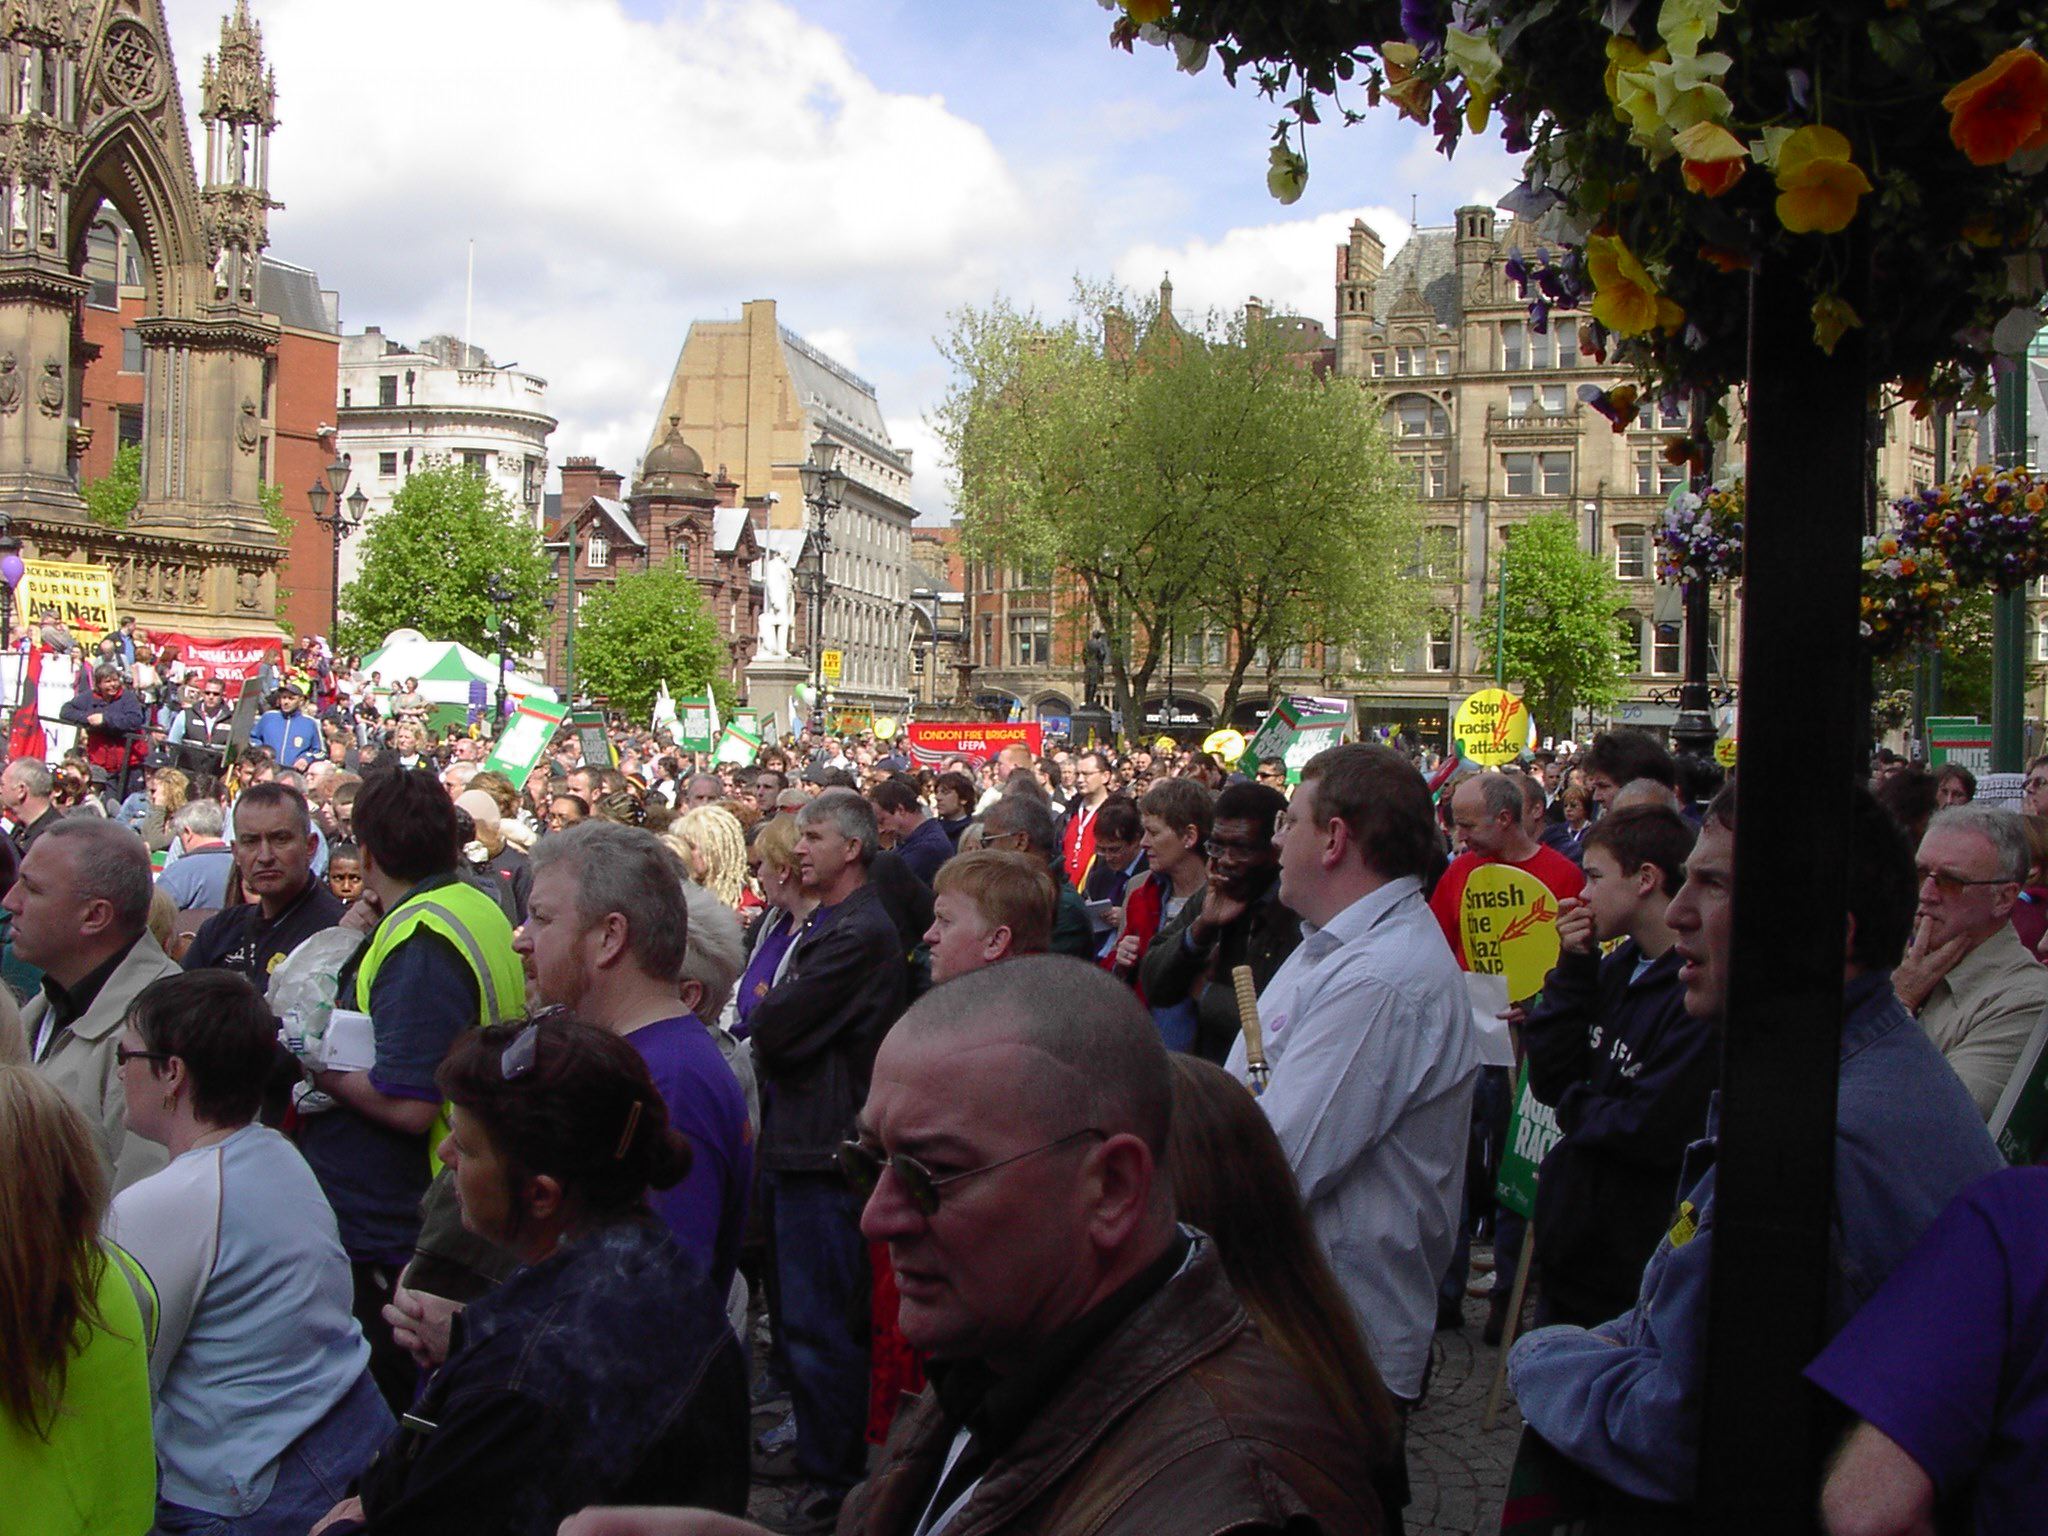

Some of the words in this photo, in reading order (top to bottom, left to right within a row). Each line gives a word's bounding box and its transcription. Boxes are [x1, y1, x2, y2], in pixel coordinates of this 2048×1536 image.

[44, 569, 60, 578] AND
[29, 582, 99, 597] BURNLEY
[66, 601, 107, 623] Nazi
[1470, 700, 1499, 716] Stop
[1459, 720, 1497, 734] racist
[919, 731, 961, 740] LONDON
[964, 731, 983, 740] FIRE
[985, 730, 1027, 739] BRIGADE
[958, 741, 987, 751] LFEPA
[1470, 739, 1519, 754] attacks
[1946, 748, 1990, 767] UNITE
[1466, 884, 1524, 909] Smash
[1467, 912, 1491, 934] the
